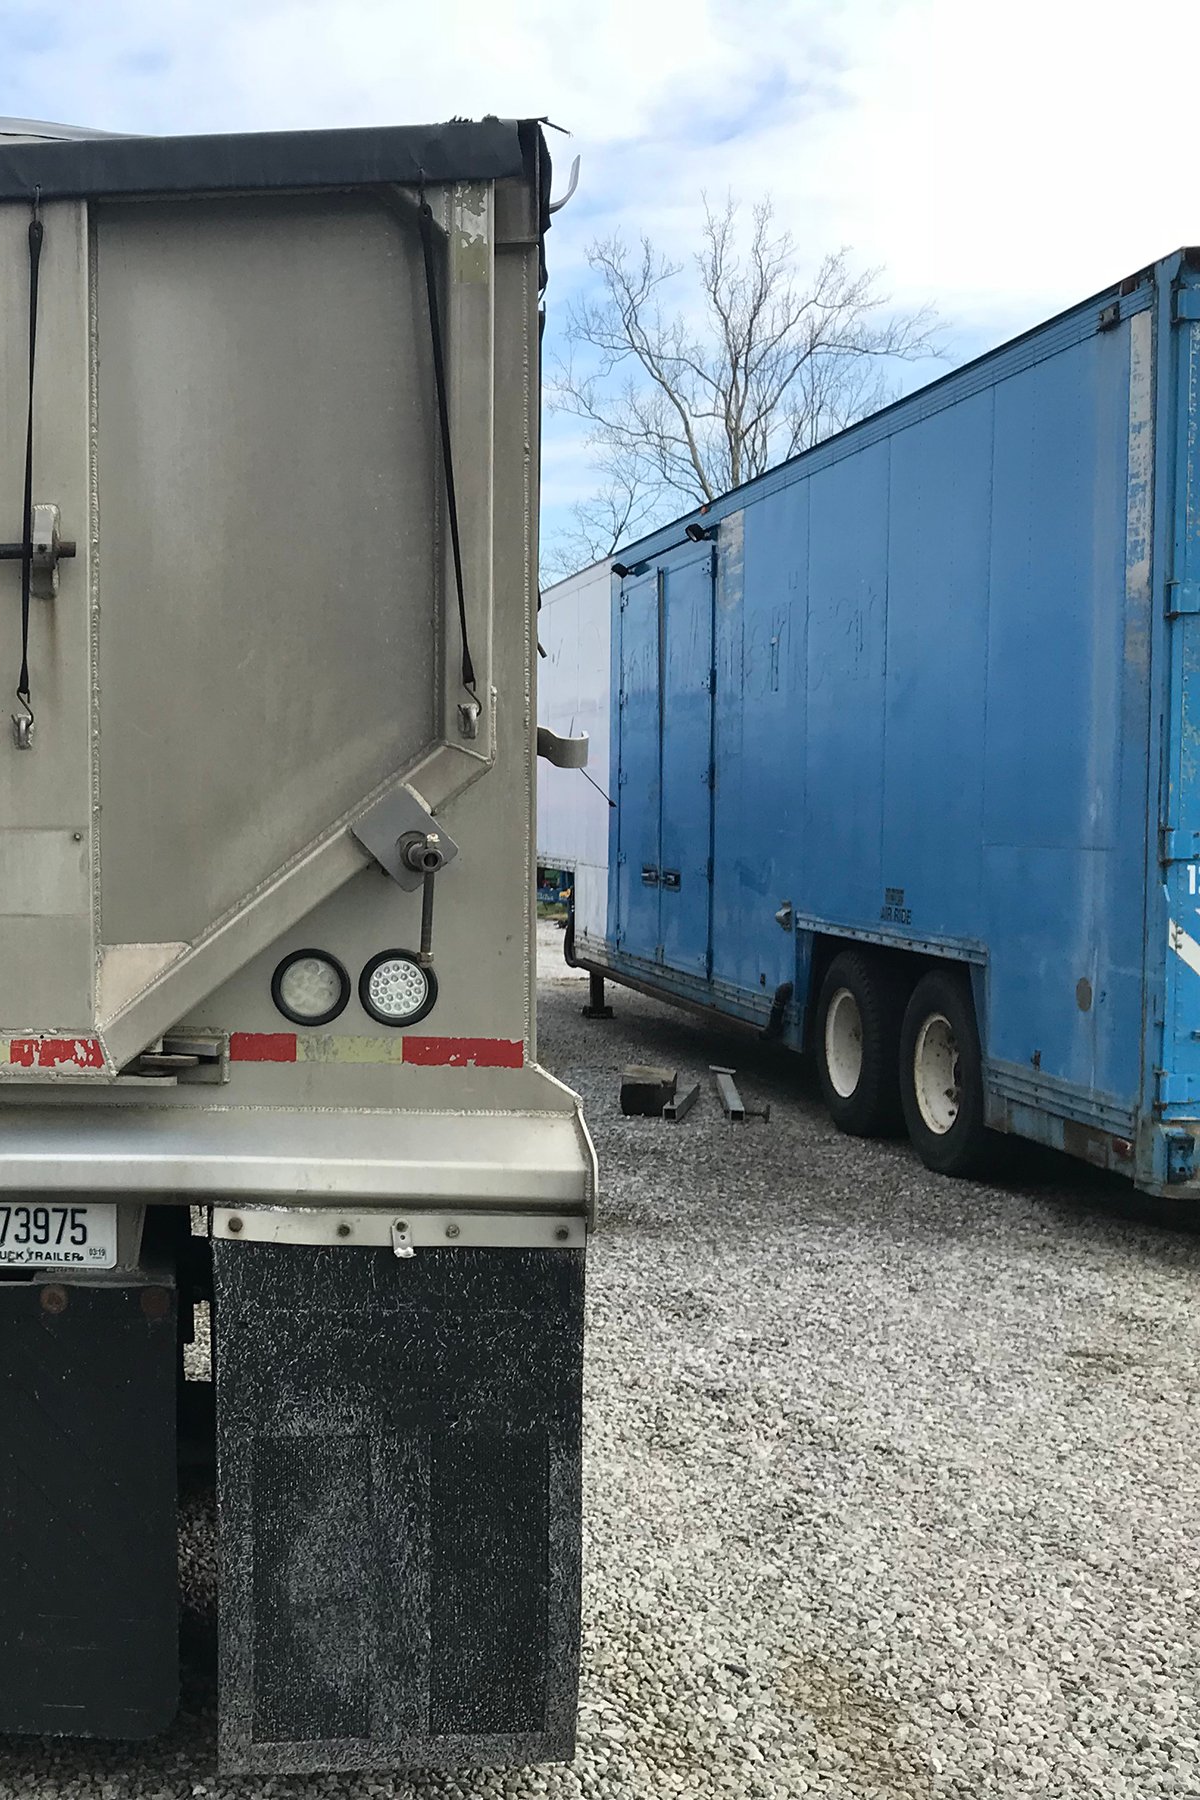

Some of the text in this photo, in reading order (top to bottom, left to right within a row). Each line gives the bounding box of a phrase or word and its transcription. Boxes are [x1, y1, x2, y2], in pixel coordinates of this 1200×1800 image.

[1187, 865, 1200, 895] 1
[894, 908, 911, 925] RIDE
[26, 1250, 79, 1261] TRAILER
